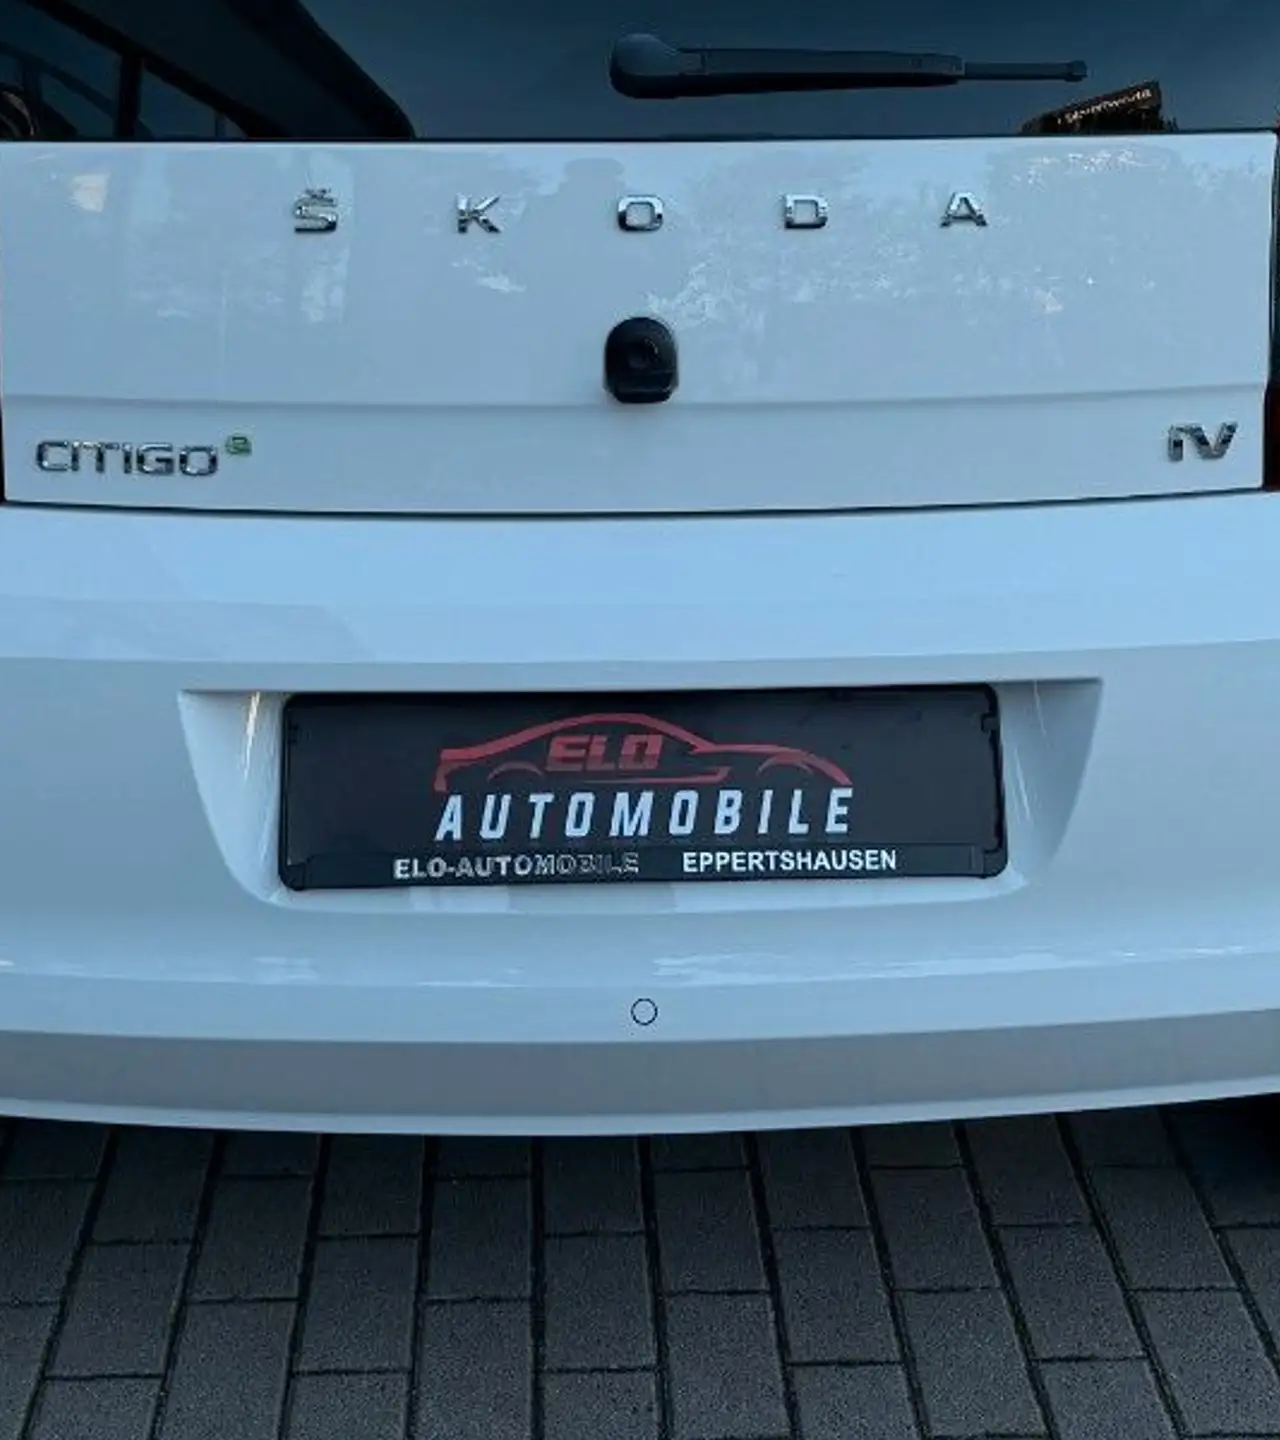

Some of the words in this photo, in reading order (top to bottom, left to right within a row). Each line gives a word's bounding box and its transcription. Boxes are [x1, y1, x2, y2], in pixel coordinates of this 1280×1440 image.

[36, 439, 218, 477] CITIGO
[546, 734, 663, 771] ELO
[435, 787, 854, 841] AUTOMOBILE
[393, 852, 640, 879] ELO-AUTOMOBILE
[682, 849, 898, 873] EPPERTSHAUSEN
